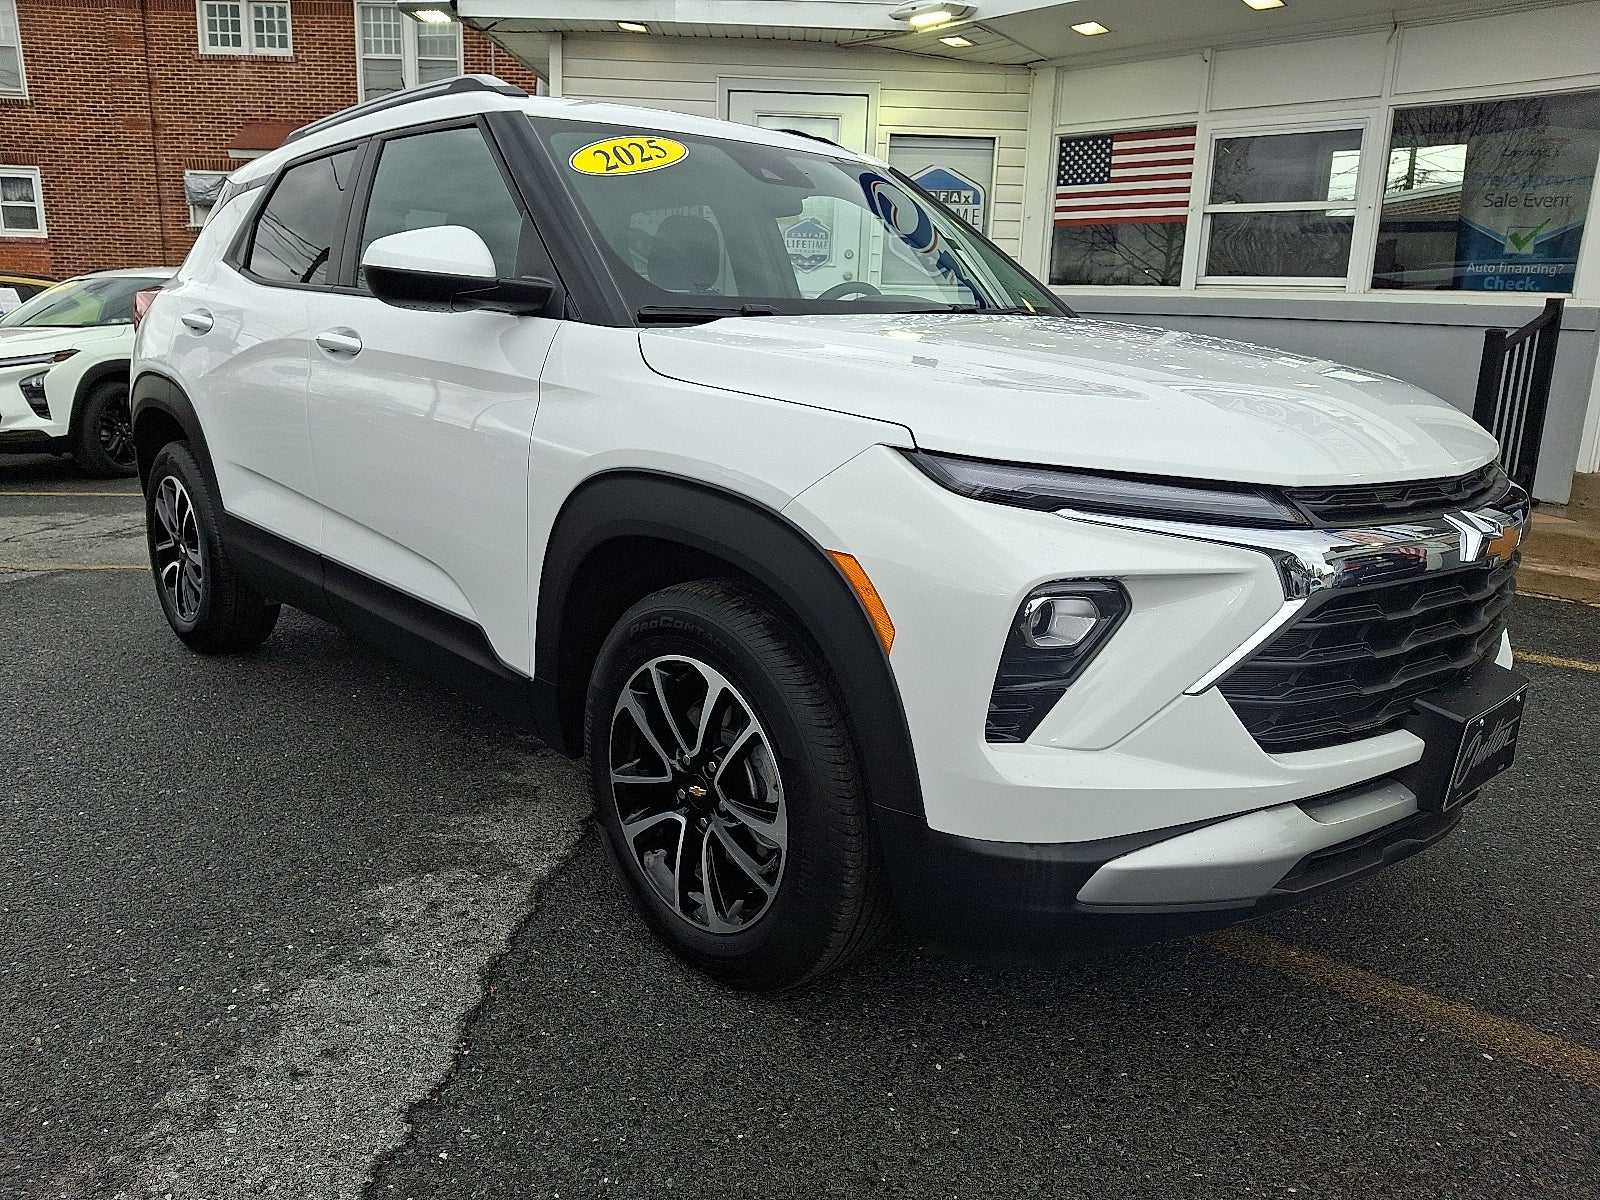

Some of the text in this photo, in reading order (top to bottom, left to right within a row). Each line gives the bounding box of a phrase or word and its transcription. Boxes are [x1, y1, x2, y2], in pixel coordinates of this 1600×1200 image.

[593, 140, 667, 171] 2025
[1483, 192, 1572, 208] Sale Event
[786, 239, 829, 250] LIFETIME
[1467, 263, 1564, 276] Auto financing?
[1483, 276, 1540, 291] Check.
